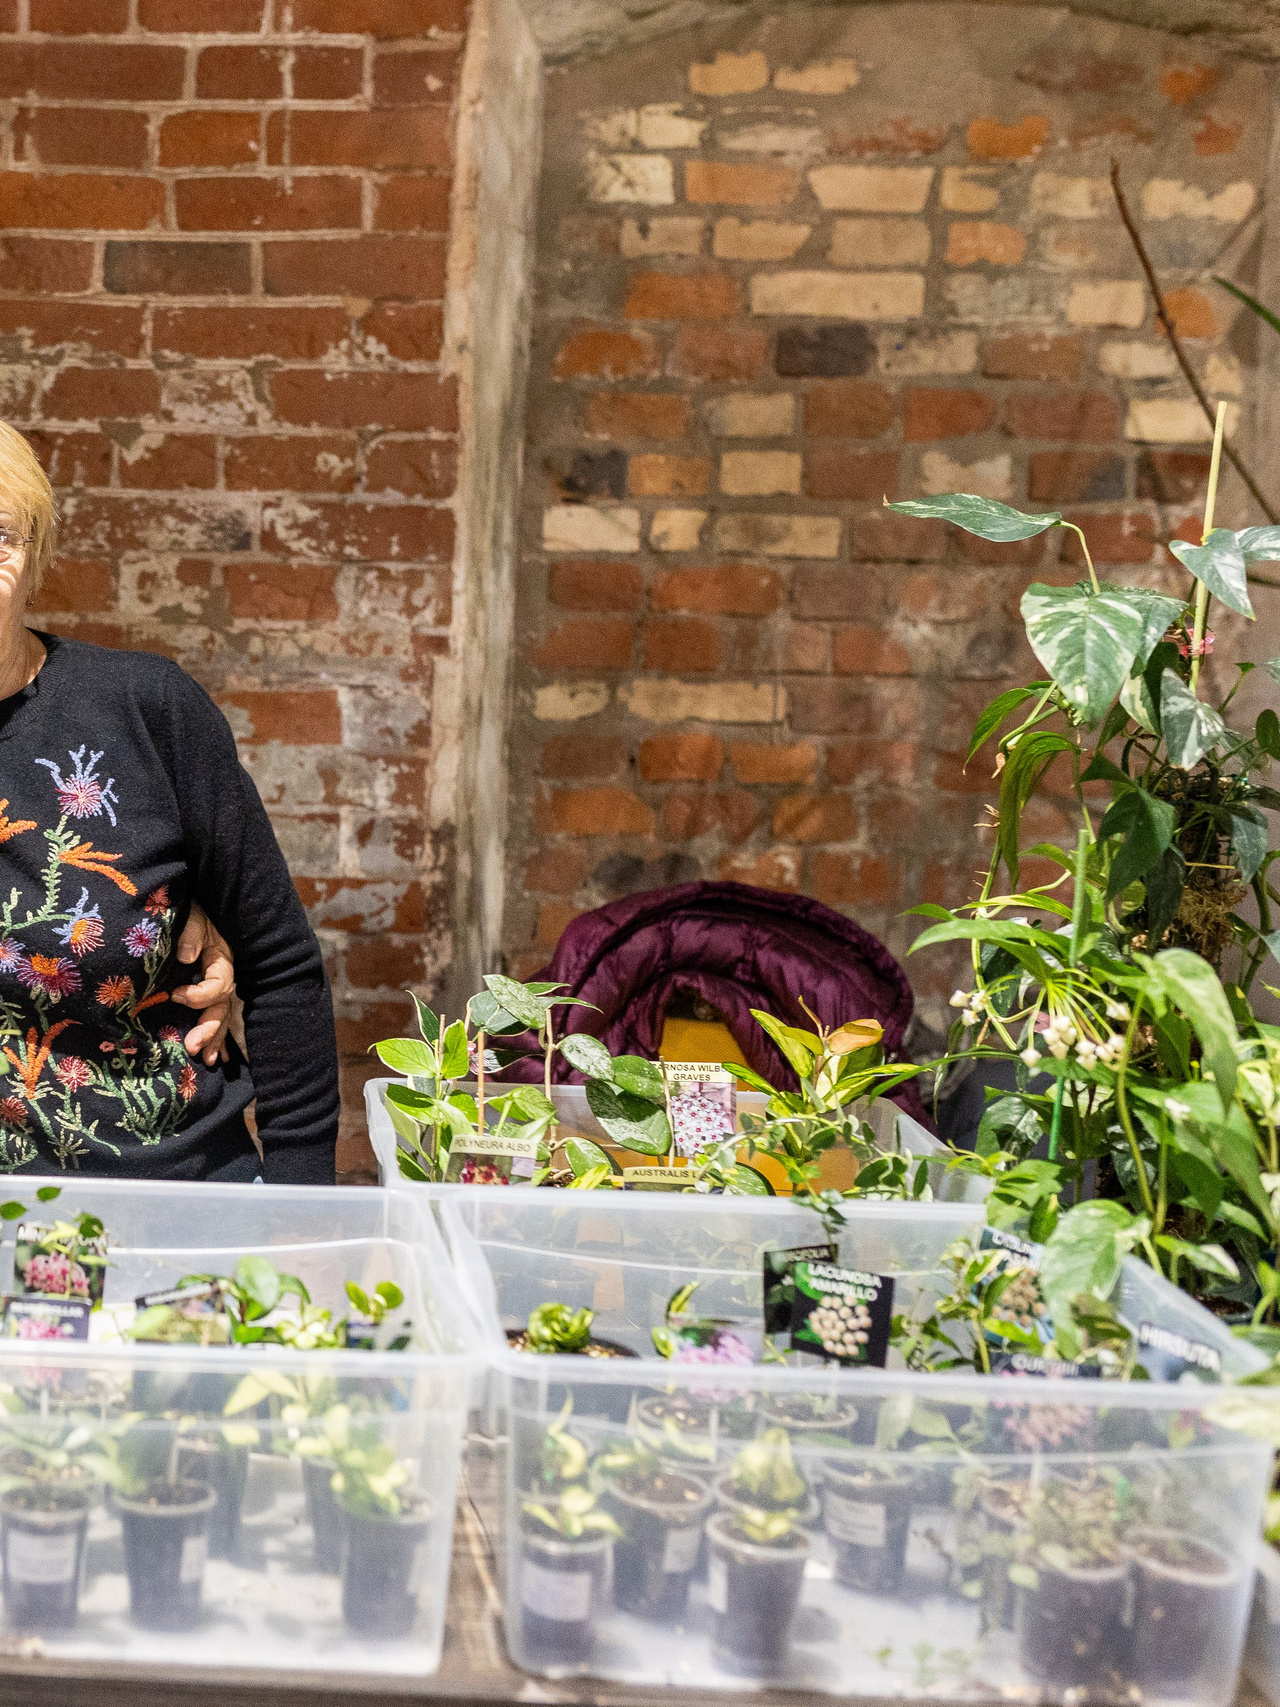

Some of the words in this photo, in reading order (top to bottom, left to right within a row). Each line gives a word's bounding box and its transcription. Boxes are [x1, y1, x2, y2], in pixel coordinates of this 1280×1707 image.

[698, 1064, 727, 1074] WILB
[674, 1073, 711, 1082] GRAVES
[453, 1139, 504, 1151] POLYNEURA
[506, 1143, 531, 1154] ALBO
[632, 1170, 689, 1179] AUSTRALIS
[808, 1263, 882, 1289] LACUNOSA
[809, 1277, 878, 1302] AMARILLO
[1140, 1324, 1220, 1371] HIRSUTA
